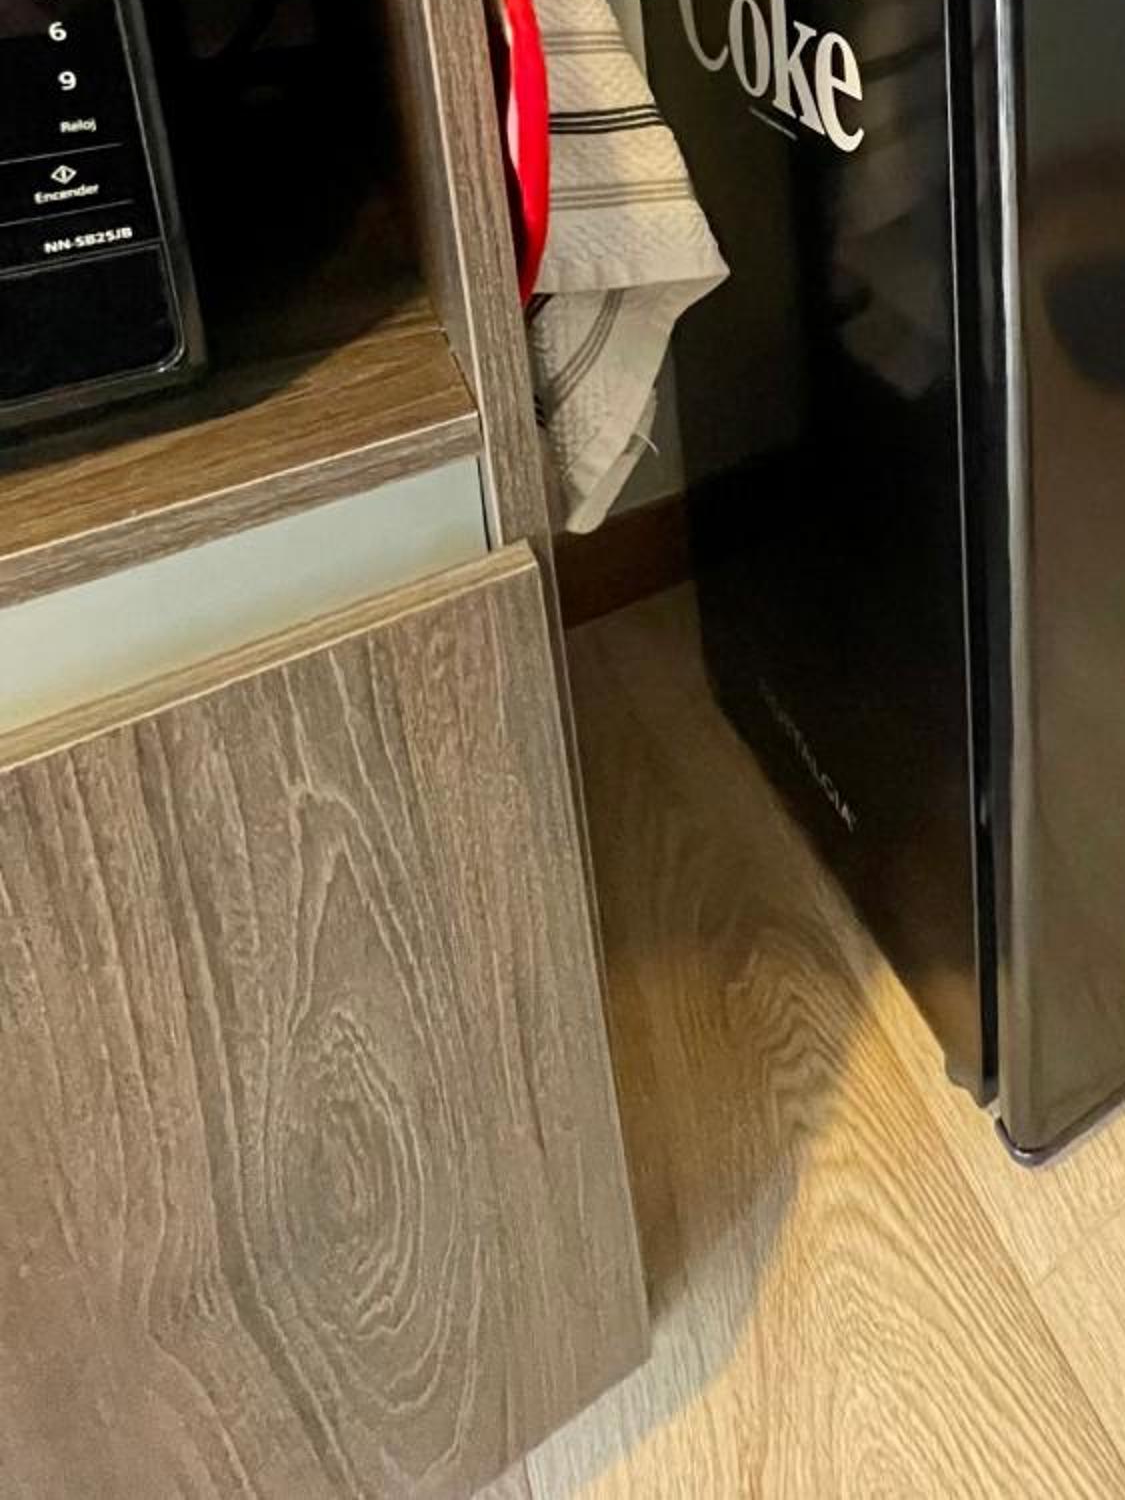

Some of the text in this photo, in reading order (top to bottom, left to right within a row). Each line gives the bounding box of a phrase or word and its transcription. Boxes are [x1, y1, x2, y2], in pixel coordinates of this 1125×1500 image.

[48, 21, 67, 42] 6
[58, 70, 77, 91] 9
[59, 118, 97, 134] Reloj
[34, 183, 99, 204] Encender
